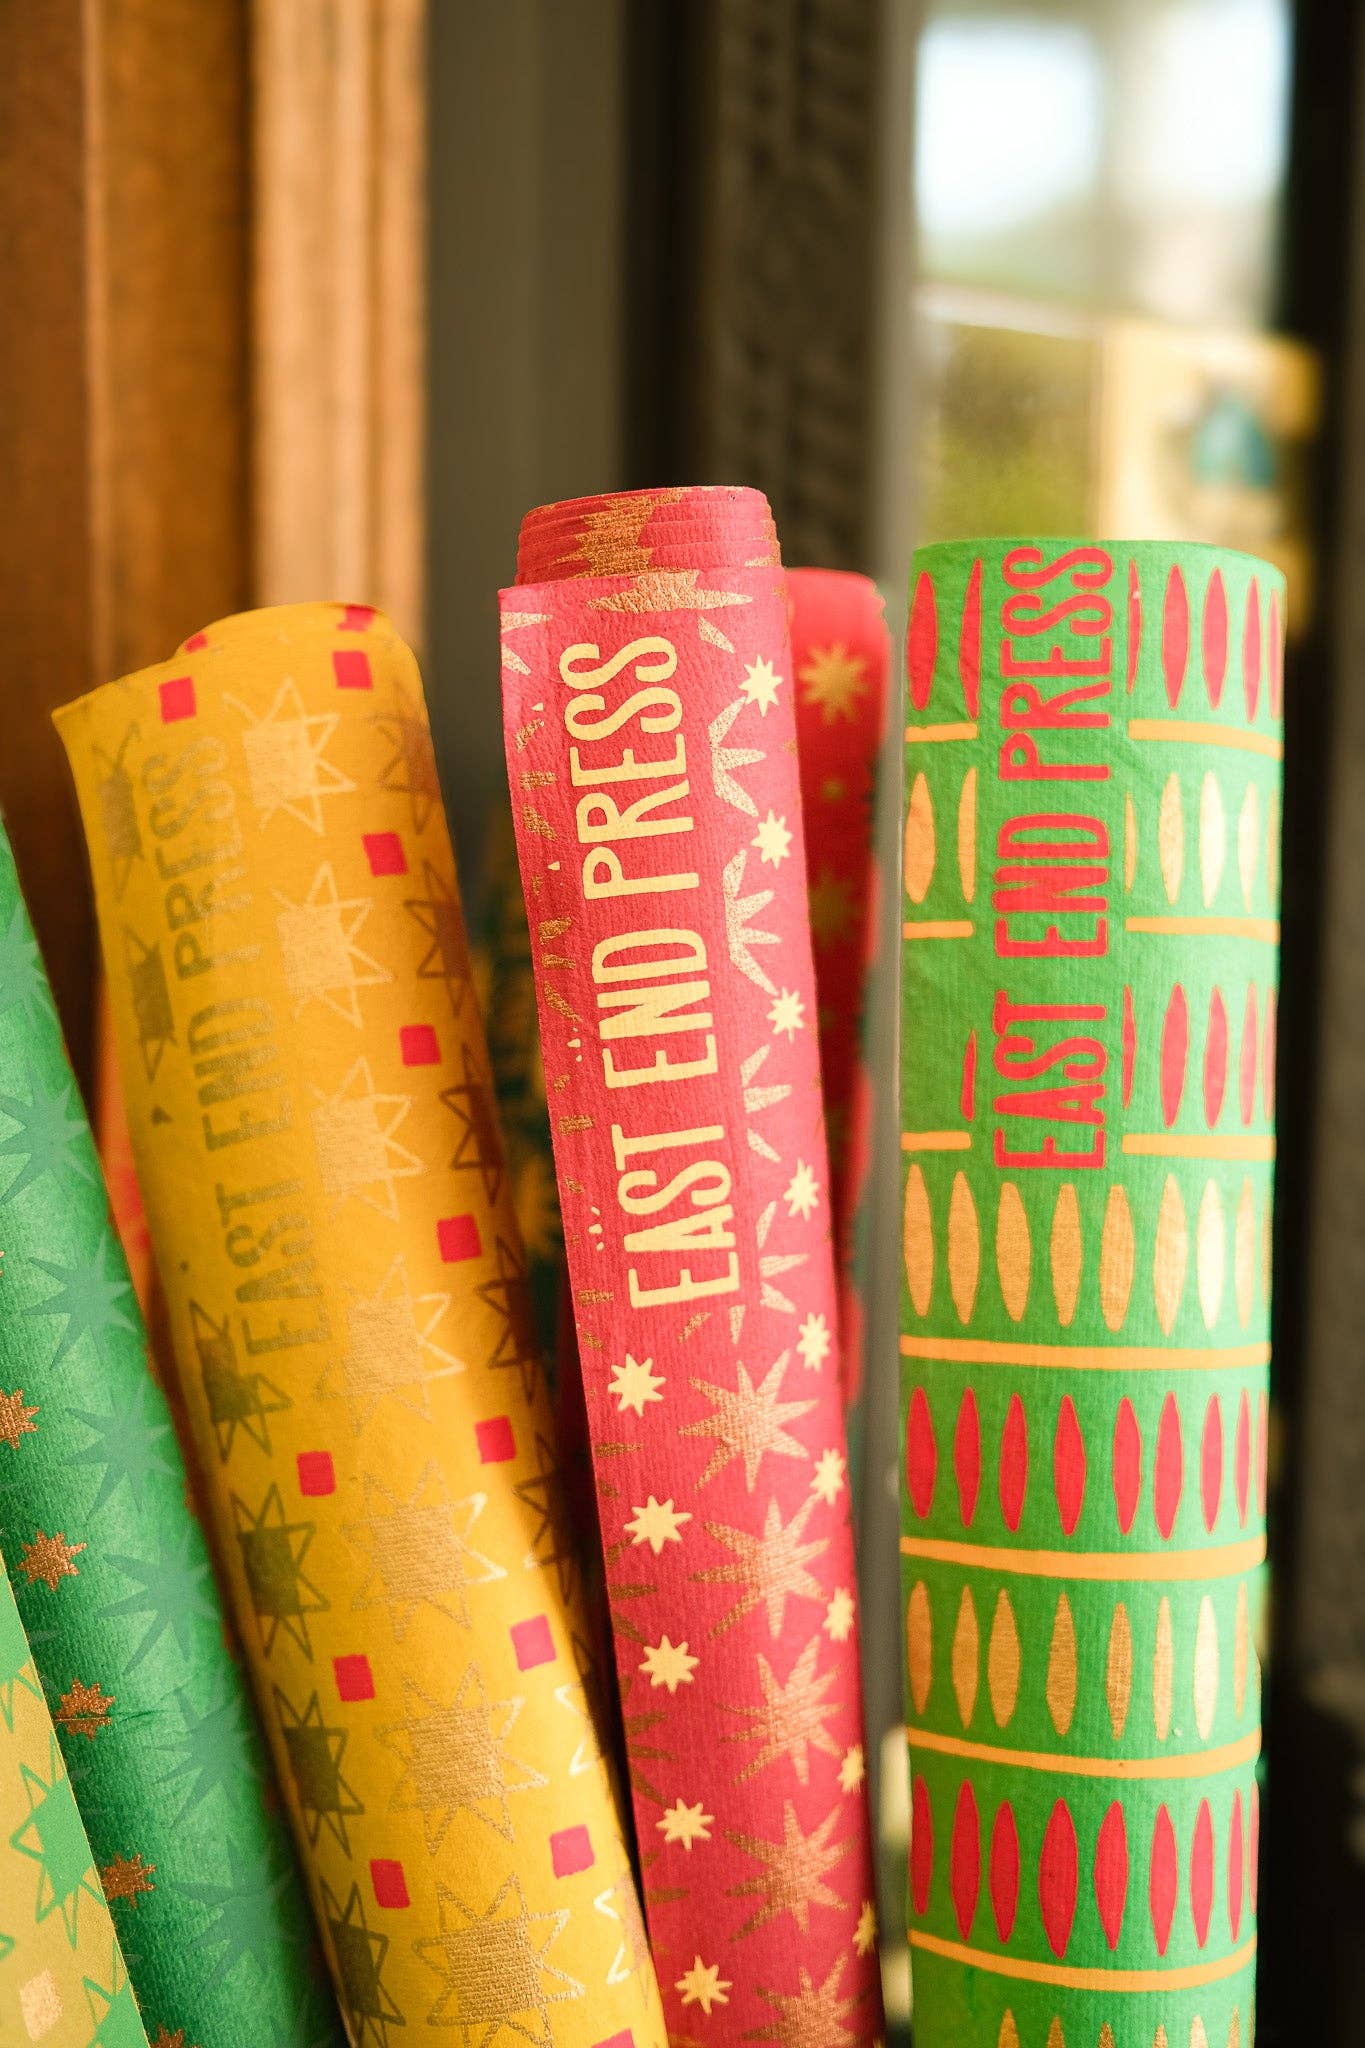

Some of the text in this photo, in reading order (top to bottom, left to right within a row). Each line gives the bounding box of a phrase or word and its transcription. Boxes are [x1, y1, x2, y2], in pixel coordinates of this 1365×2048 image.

[140, 735, 333, 1357] EAST END PRESS
[558, 635, 741, 1309] EAST END PRESS
[991, 546, 1115, 1170] EAST END PRESS
